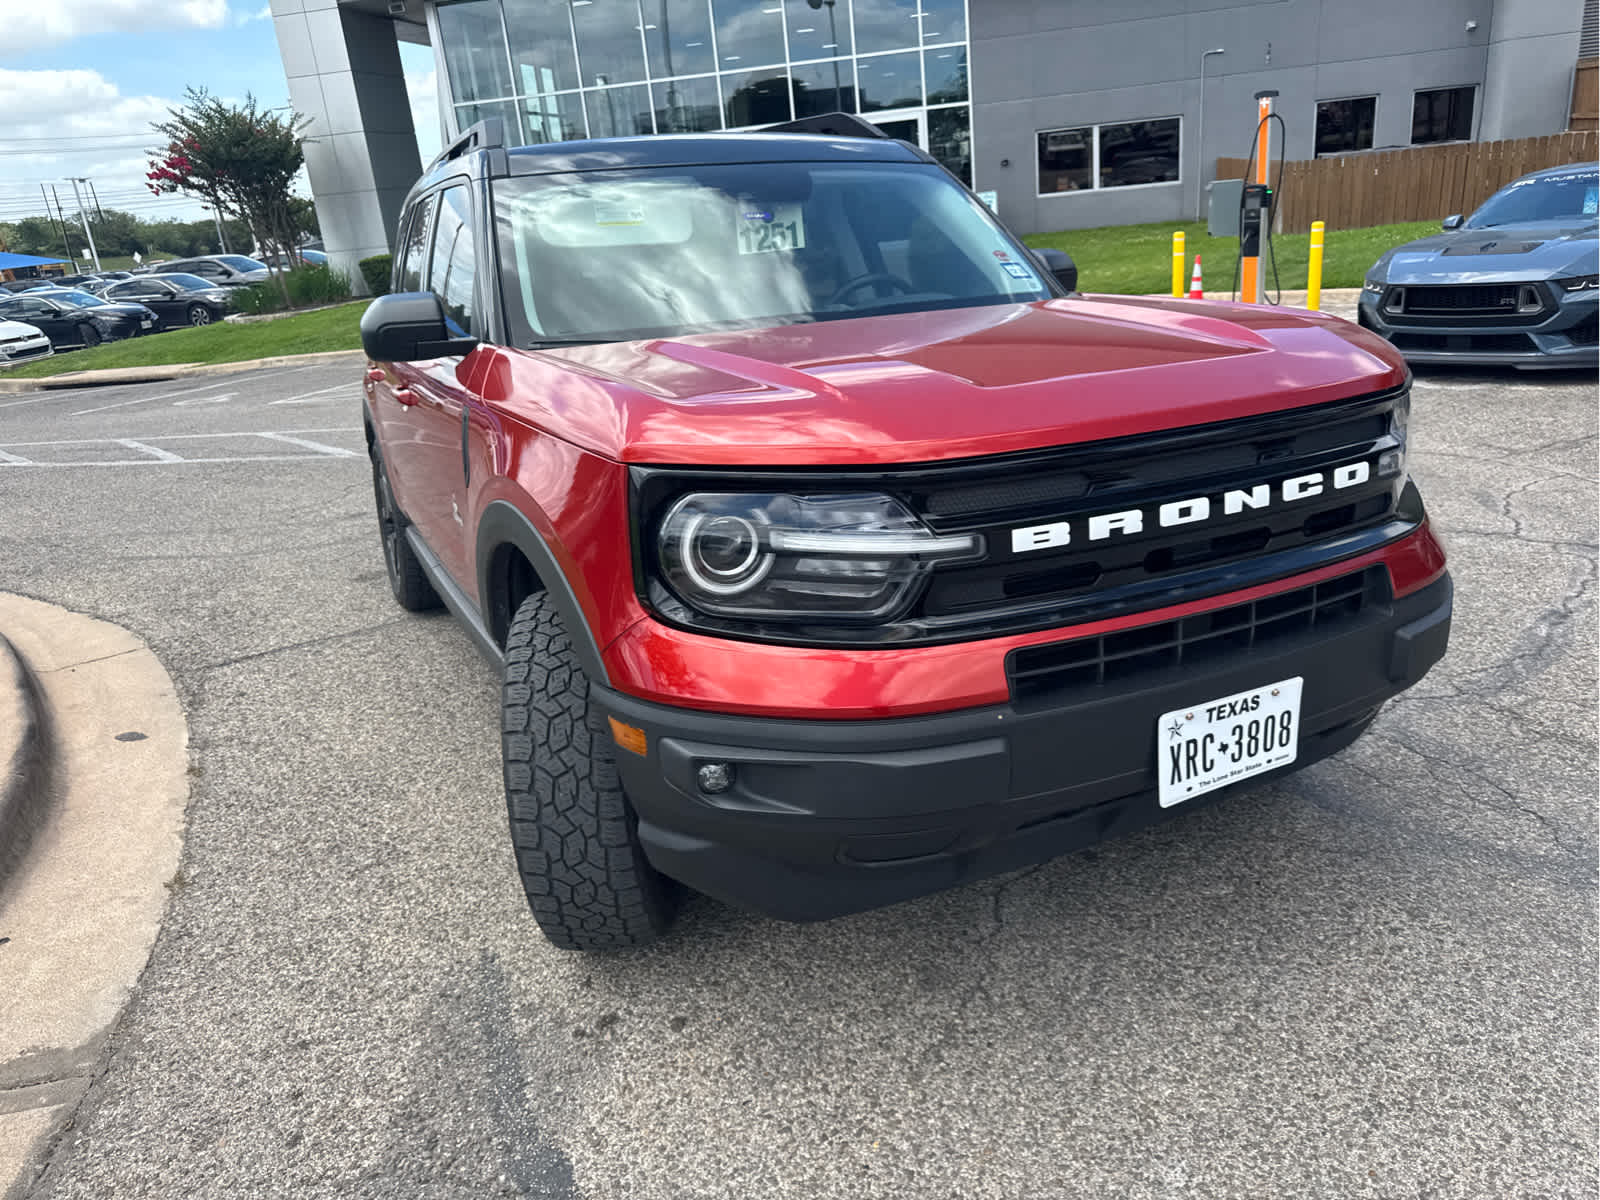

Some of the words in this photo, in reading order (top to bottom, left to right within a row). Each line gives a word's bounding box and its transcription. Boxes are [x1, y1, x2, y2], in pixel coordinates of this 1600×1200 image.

[739, 221, 799, 252] 1251
[1011, 461, 1369, 553] BRONCO
[1206, 695, 1260, 723] TEXAS
[1170, 733, 1215, 785] XRC
[1231, 710, 1292, 763] 3808
[1212, 774, 1228, 783] Lone
[1230, 769, 1244, 777] Star
[1245, 763, 1262, 771] State
